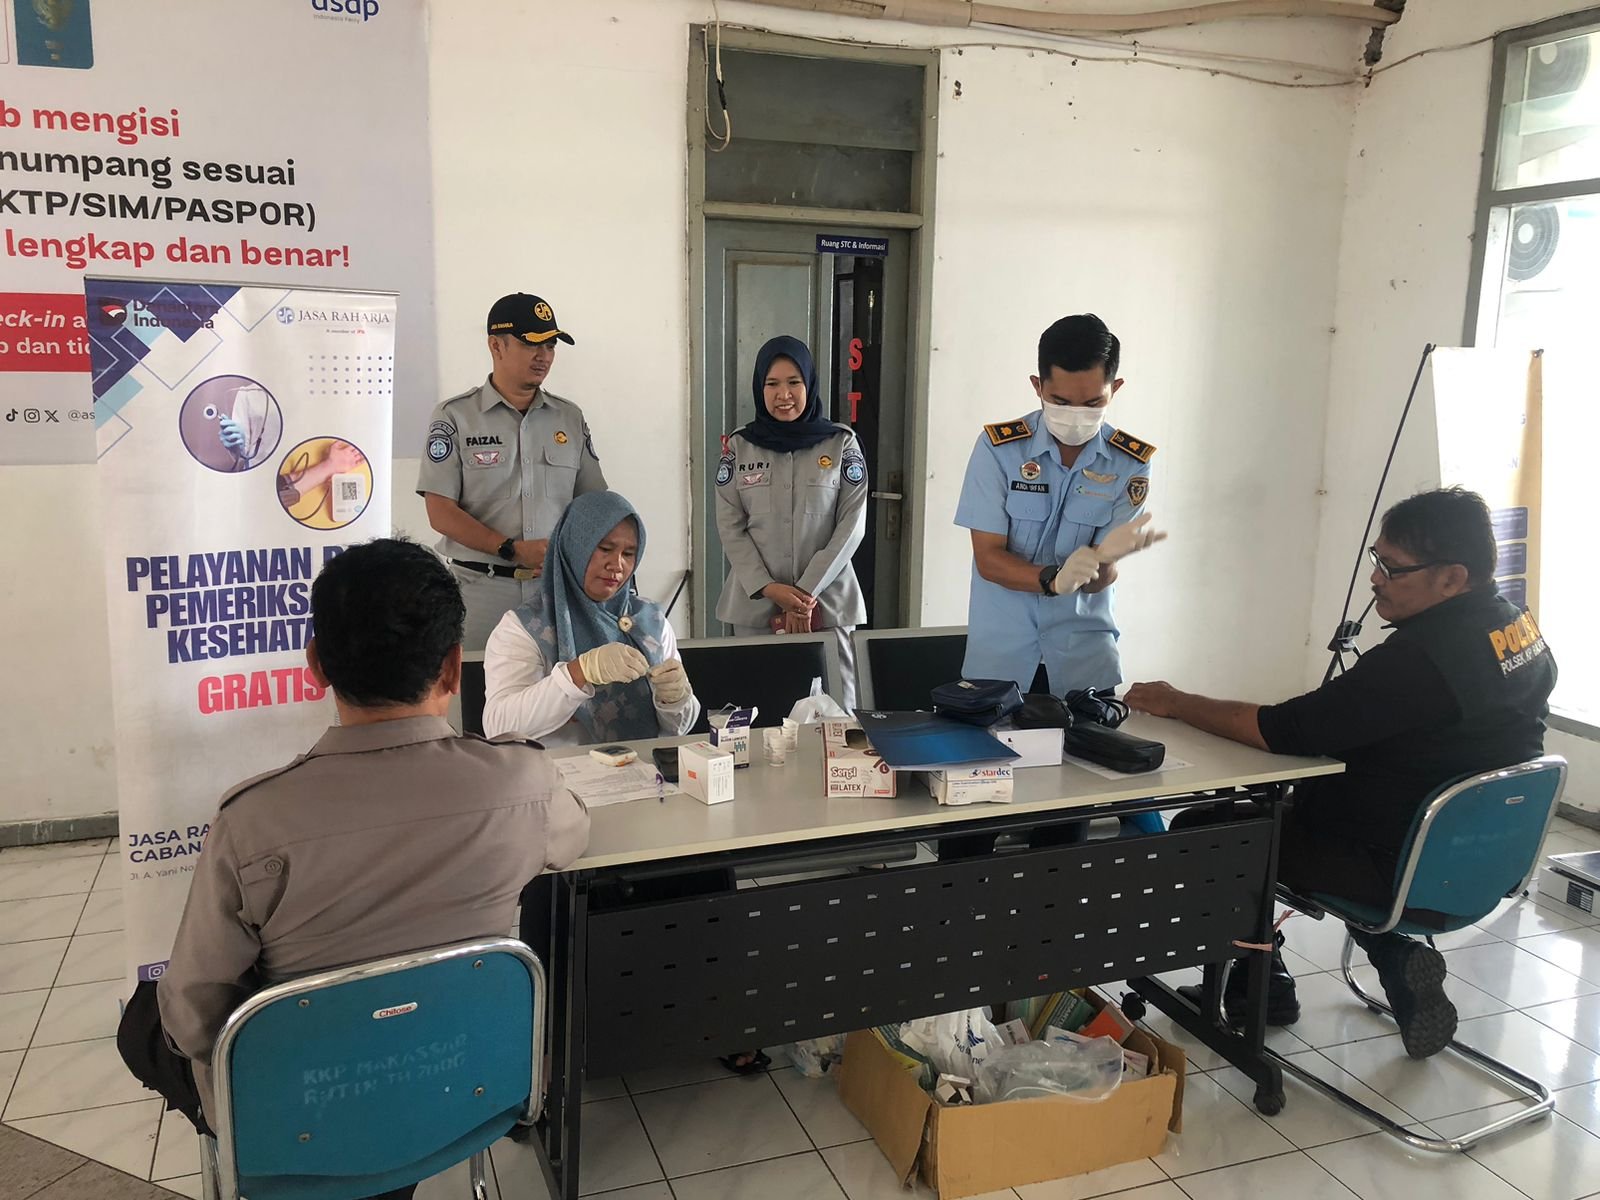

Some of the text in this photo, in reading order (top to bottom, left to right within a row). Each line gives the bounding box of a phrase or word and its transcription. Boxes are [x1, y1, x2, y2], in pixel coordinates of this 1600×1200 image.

[33, 106, 180, 145] mengisi
[182, 158, 296, 186] sesuai
[0, 188, 316, 232] KTP/SIM/PASPOR)
[5, 228, 350, 270] lengkap dan benar!
[821, 239, 886, 251] Ruang STC & Informasi
[0, 309, 66, 328] ck-in
[298, 310, 390, 325] JASA RAHARJA
[16, 337, 60, 354] dan
[466, 435, 504, 447] FAIZAL
[738, 461, 770, 473] RURI
[126, 547, 312, 592] PELAYANAN
[146, 581, 314, 629] PEMERIKS
[196, 666, 326, 714] GRATIS
[830, 766, 858, 780] Sensi
[981, 767, 1011, 777] stardec
[839, 783, 862, 792] LATEX
[128, 829, 182, 847] JASA
[129, 840, 202, 863] CABAN
[156, 867, 178, 877] Yani
